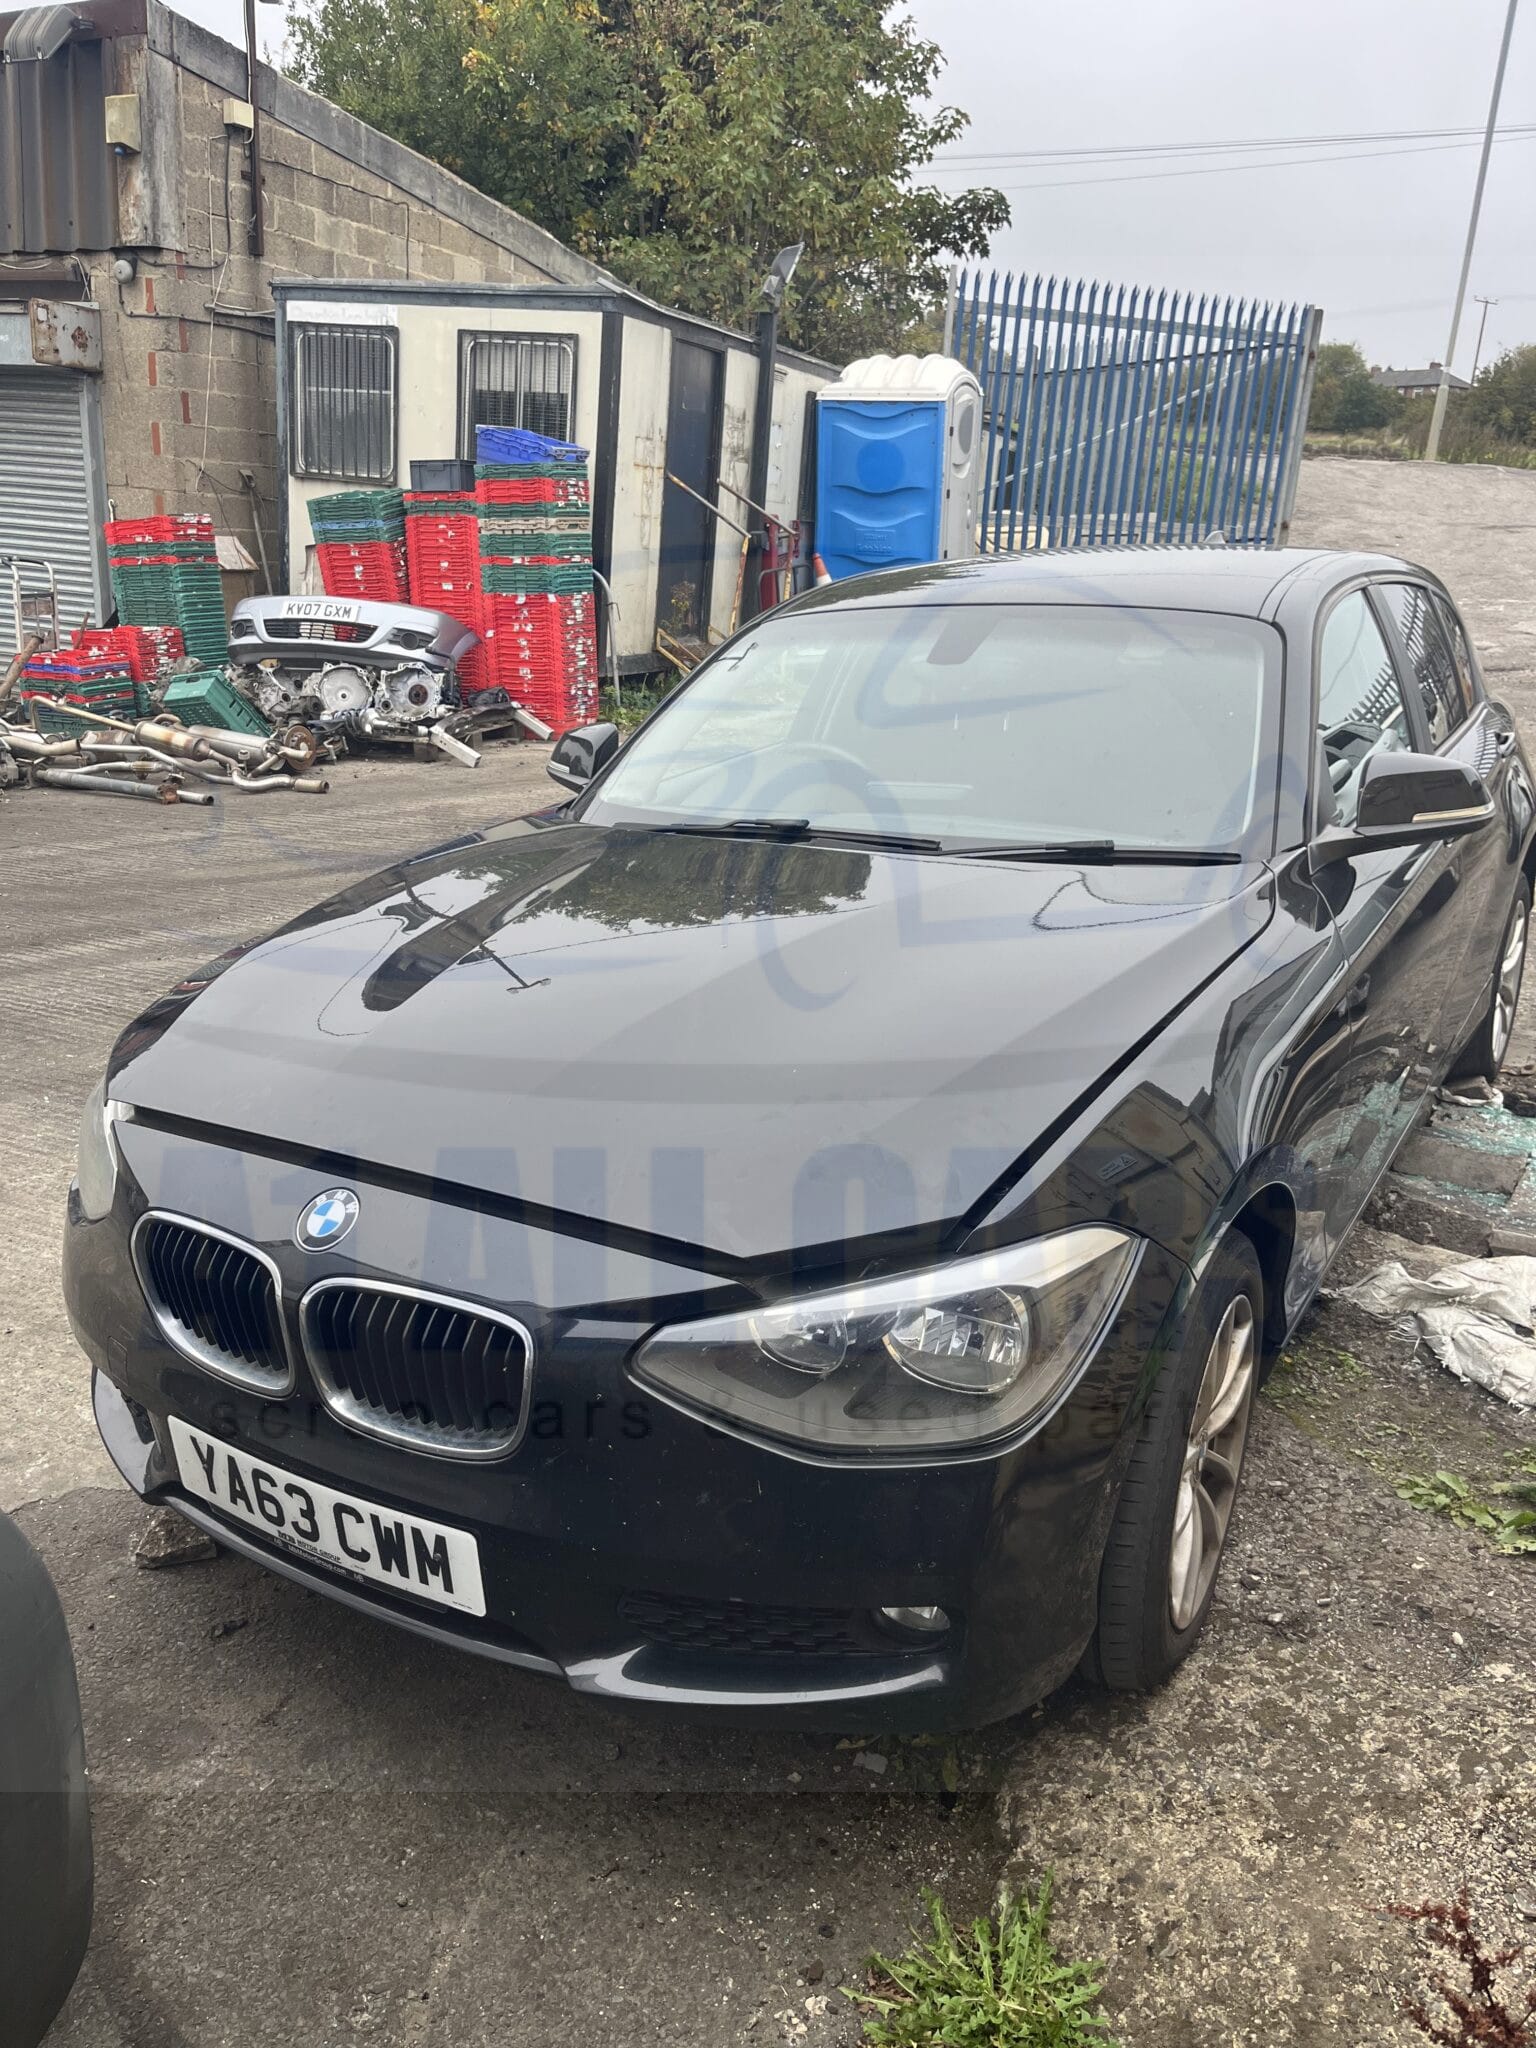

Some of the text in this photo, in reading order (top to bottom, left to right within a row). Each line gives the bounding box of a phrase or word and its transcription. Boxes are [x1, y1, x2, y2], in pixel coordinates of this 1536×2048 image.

[286, 603, 352, 619] KV07 GXM
[314, 1189, 358, 1214] BMW
[189, 1435, 455, 1595] YA63 CWM
